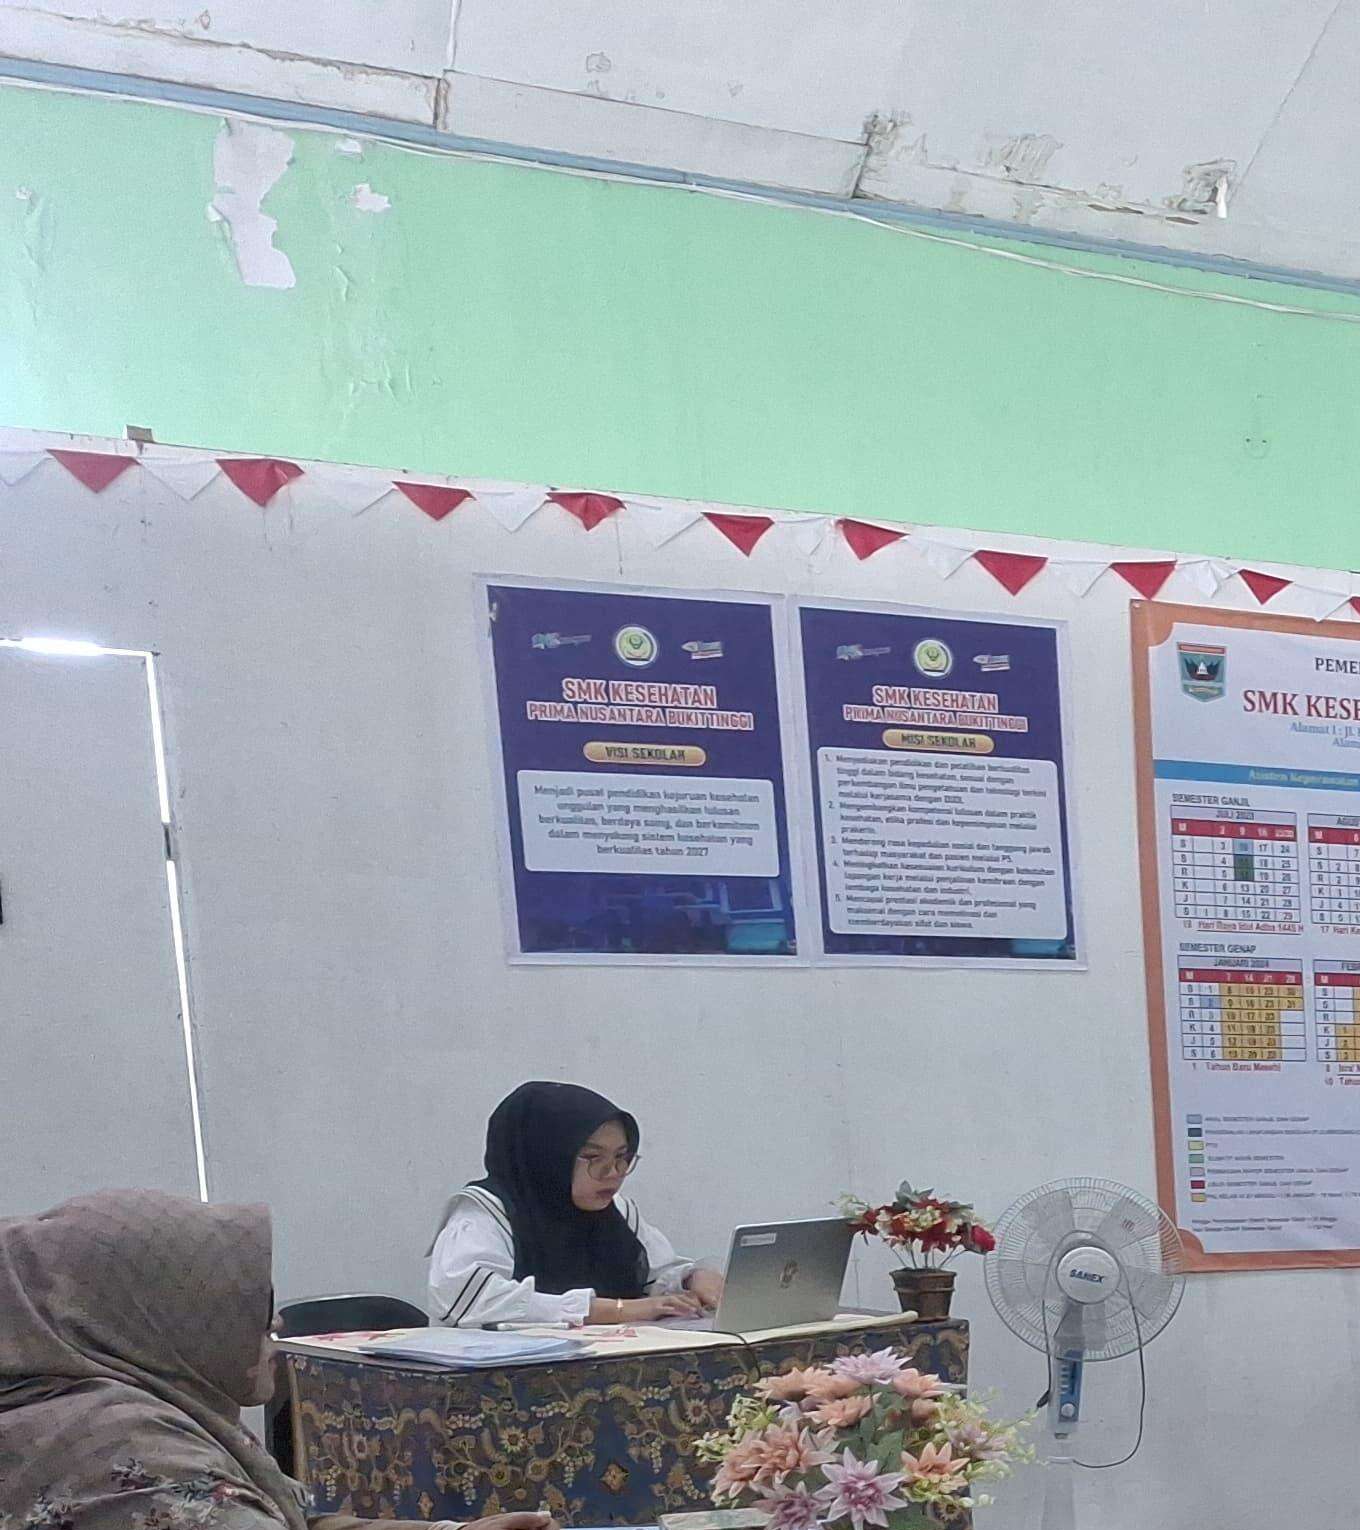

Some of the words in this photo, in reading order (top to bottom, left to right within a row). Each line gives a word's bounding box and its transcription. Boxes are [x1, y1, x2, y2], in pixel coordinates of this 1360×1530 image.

[563, 679, 606, 702] SMK
[611, 681, 716, 707] KESEHATAN
[873, 686, 909, 705] SMK
[911, 688, 998, 712] KESEHATAN
[1243, 689, 1299, 716] SMK
[528, 702, 577, 720] PRIMA
[578, 704, 665, 725] NUSANTARA
